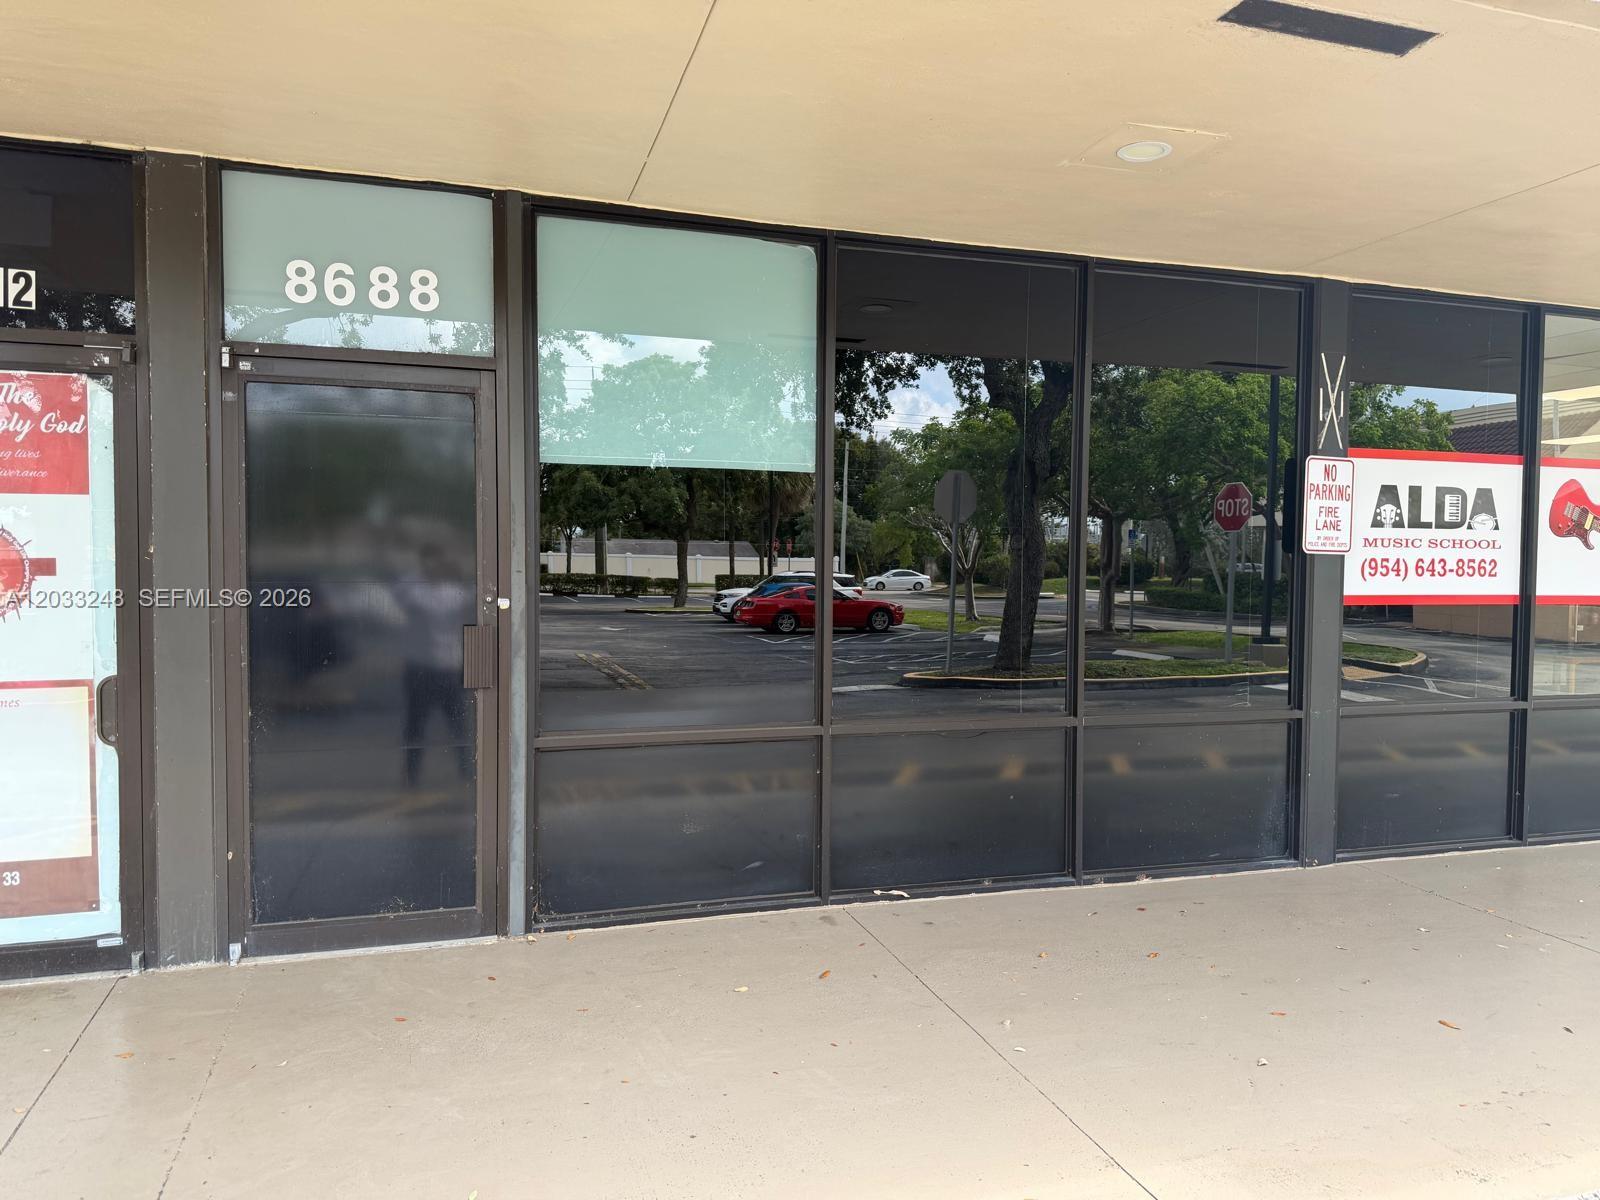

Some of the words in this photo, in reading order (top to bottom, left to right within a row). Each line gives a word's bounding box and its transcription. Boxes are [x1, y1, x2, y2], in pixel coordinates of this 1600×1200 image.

[284, 259, 440, 312] 8688
[40, 412, 86, 434] God
[14, 449, 41, 458] lives
[1324, 464, 1337, 482] NO
[1309, 483, 1351, 502] PARKING
[1318, 506, 1339, 518] FIRE
[1370, 484, 1500, 531] ALDA
[1316, 520, 1341, 531] LANE
[1362, 537, 1422, 548] MUSIC
[1428, 538, 1502, 549] SCHOOL
[1360, 557, 1409, 582] (954)
[1415, 558, 1498, 577] 643-8562
[2, 871, 21, 887] 33
